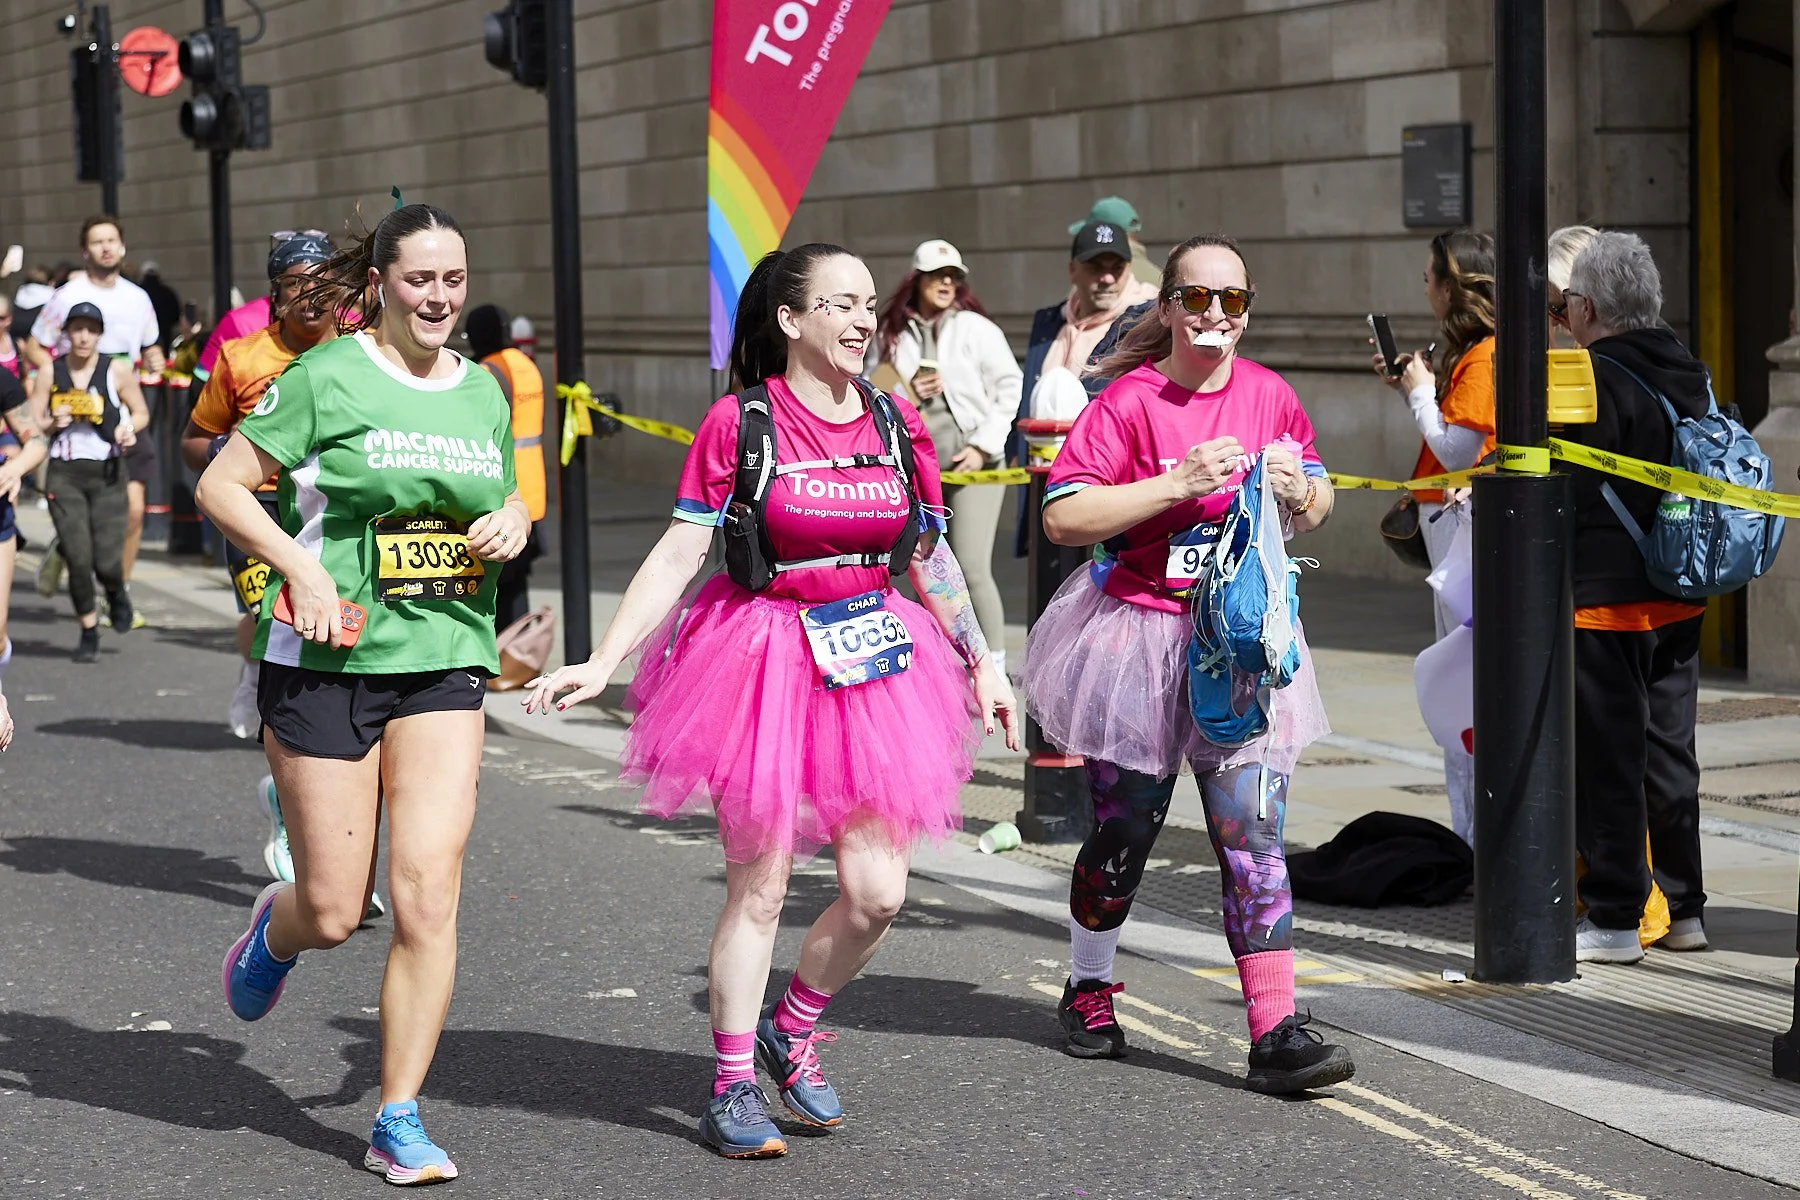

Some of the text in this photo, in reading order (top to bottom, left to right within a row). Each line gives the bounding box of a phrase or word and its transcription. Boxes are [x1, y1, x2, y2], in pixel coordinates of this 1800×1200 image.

[744, 0, 819, 66] To
[799, 61, 823, 91] The
[367, 452, 504, 480] CANCER SUPPOR
[784, 503, 802, 514] The
[804, 508, 855, 519] pregnancy
[856, 508, 875, 518] and
[876, 509, 897, 519] baby
[388, 541, 475, 570] 13038
[847, 596, 878, 612] CHAR
